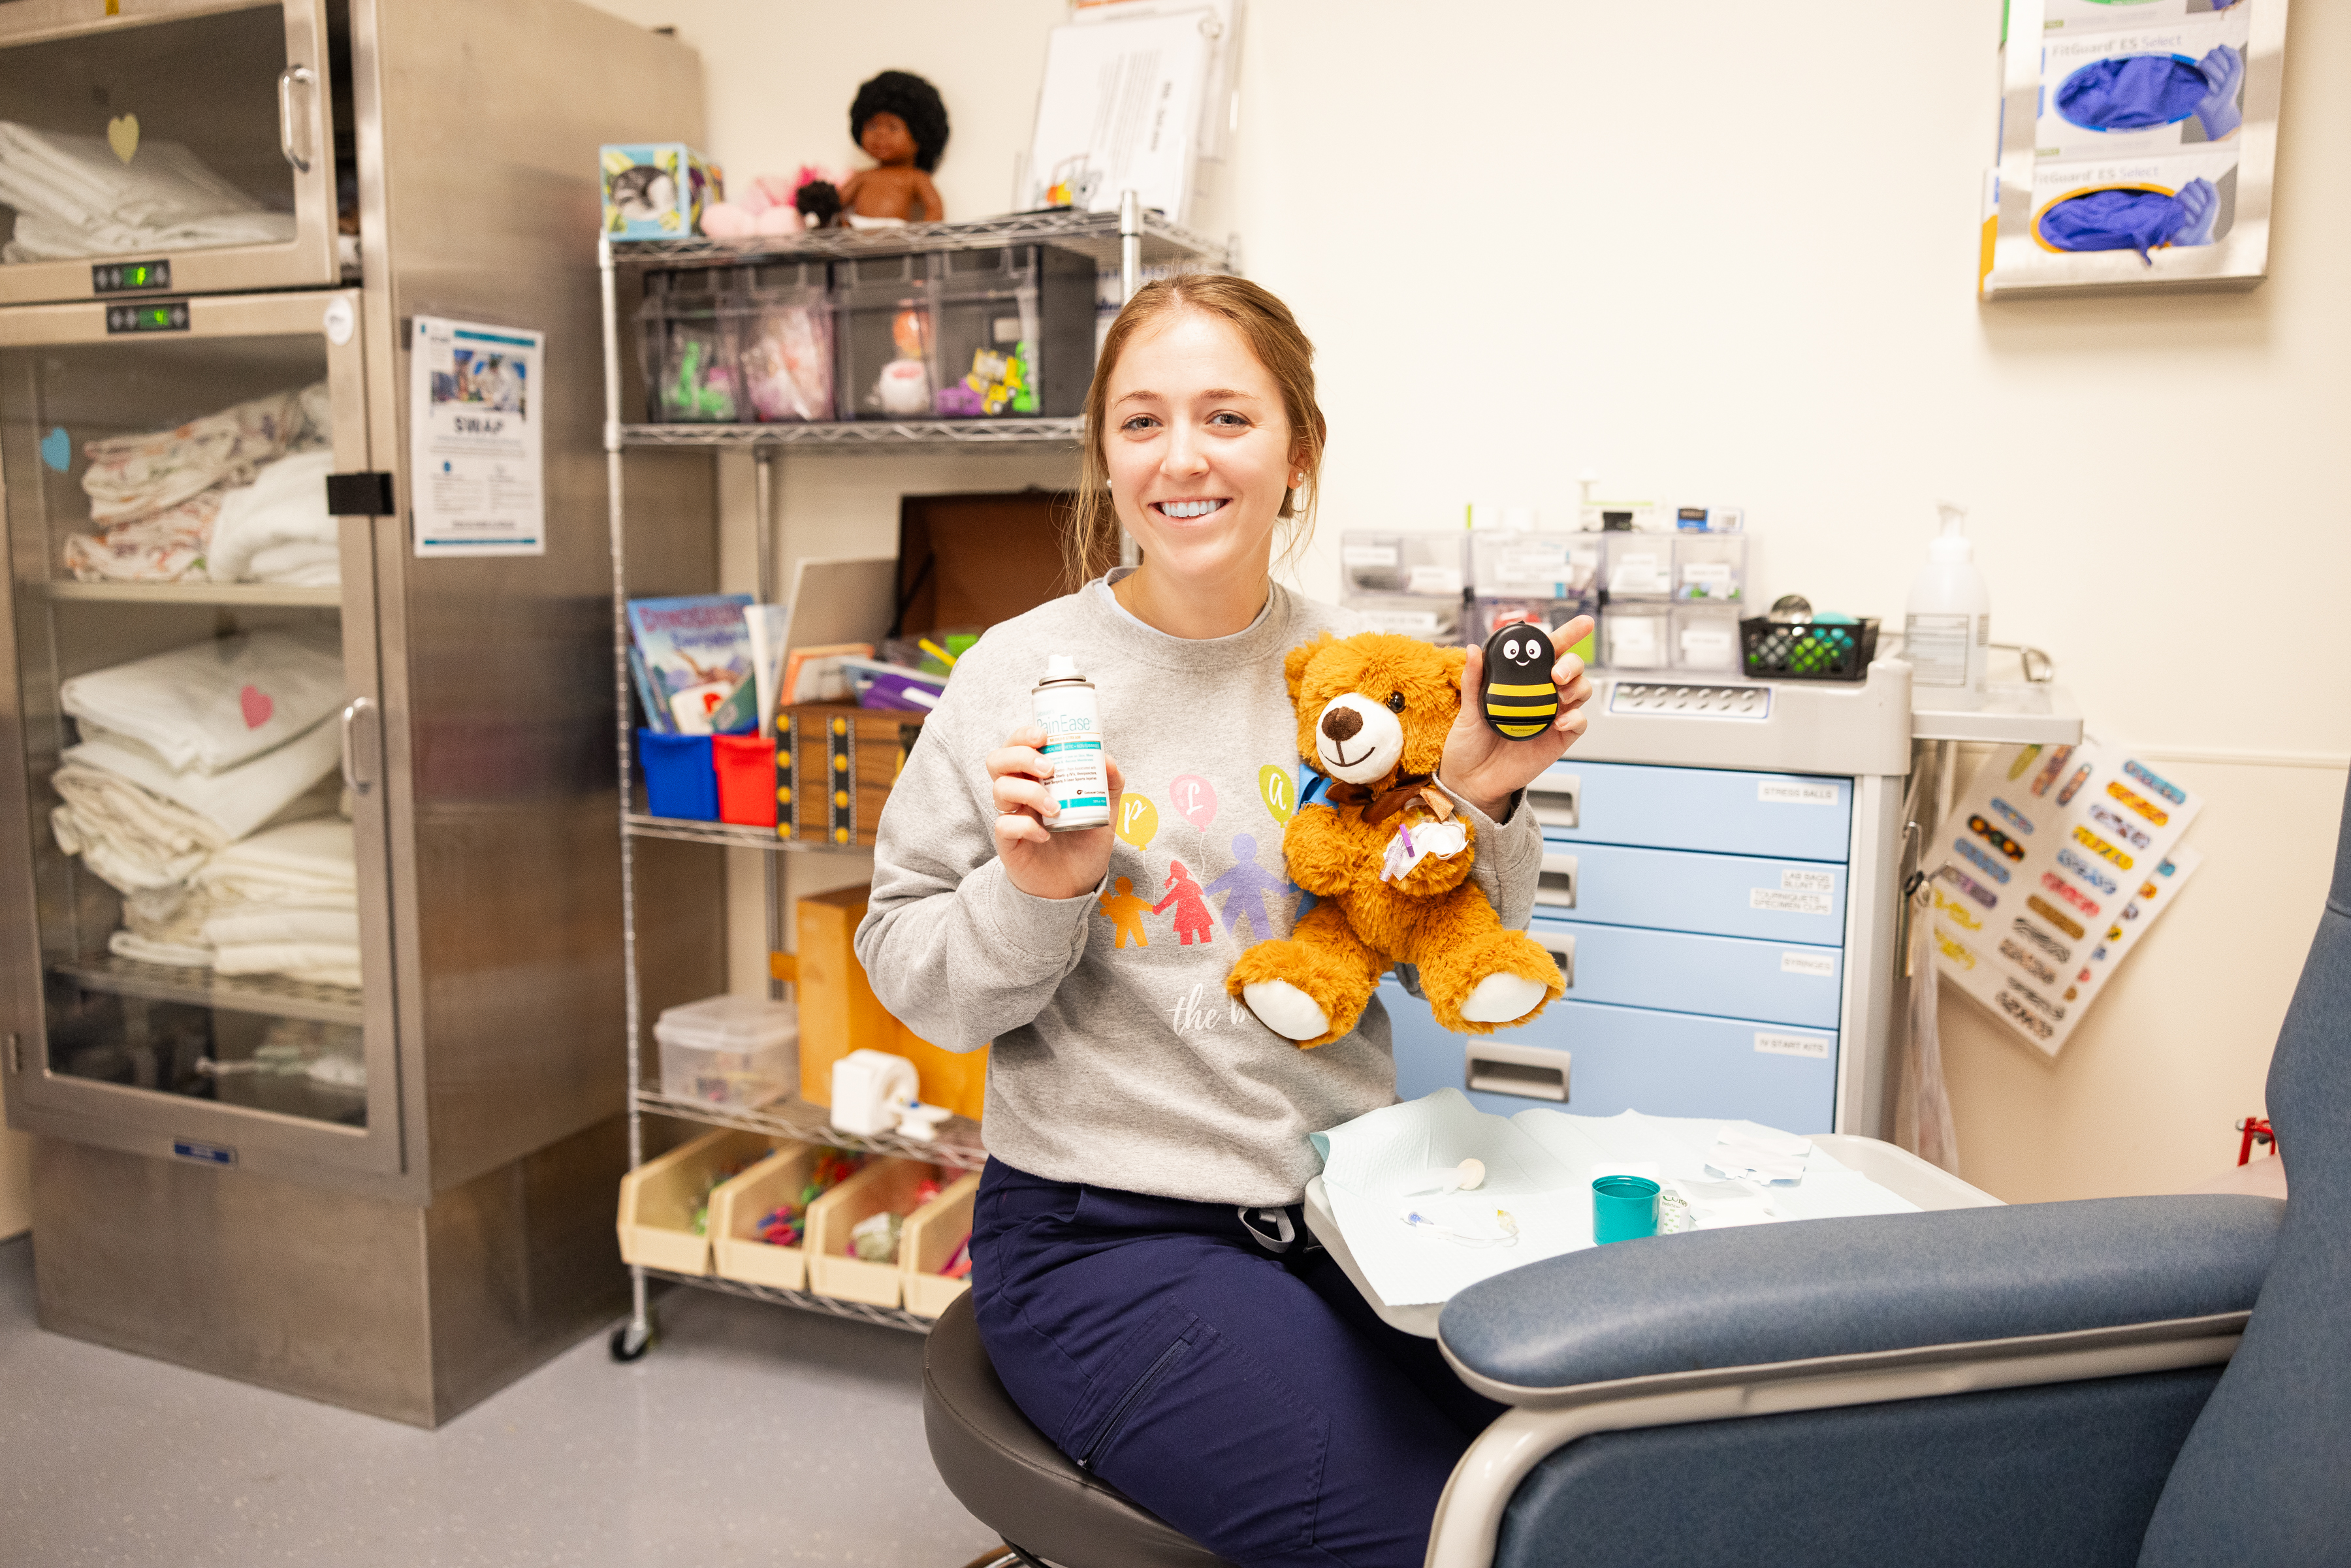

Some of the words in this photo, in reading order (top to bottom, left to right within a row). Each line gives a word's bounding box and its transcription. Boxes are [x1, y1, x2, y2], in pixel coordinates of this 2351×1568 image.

[2120, 37, 2137, 49] ES
[2141, 35, 2181, 47] Select
[2098, 167, 2115, 180] ES
[2120, 166, 2158, 178] Select
[1765, 788, 1800, 798] STRESS
[1802, 789, 1832, 799] BALLS
[1783, 880, 1813, 889] BLUNT
[1755, 890, 1819, 903] TOURNIQUETS
[1753, 899, 1800, 909] SPECIMEN
[1785, 958, 1831, 970] SYRINGES
[1166, 983, 1222, 1036] the
[1771, 1040, 1800, 1049] START
[1803, 1043, 1824, 1053] KITS
